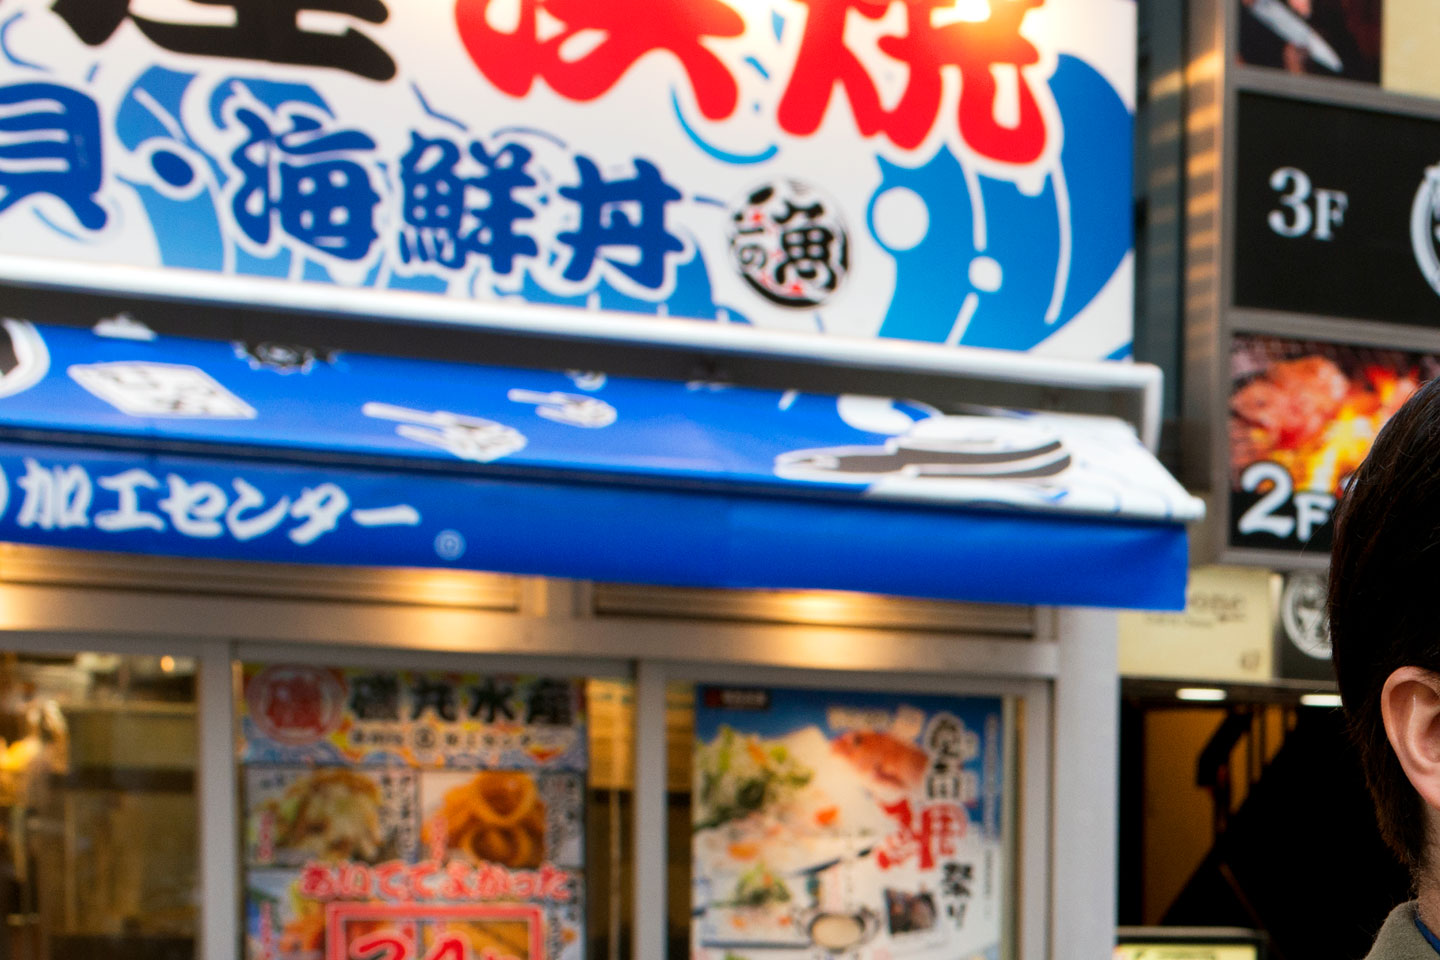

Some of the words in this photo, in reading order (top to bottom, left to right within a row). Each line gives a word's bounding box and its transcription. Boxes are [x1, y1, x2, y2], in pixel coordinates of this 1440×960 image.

[1267, 167, 1348, 241] 3F
[17, 458, 421, 545] 加工センター
[1238, 461, 1338, 541] 2F
